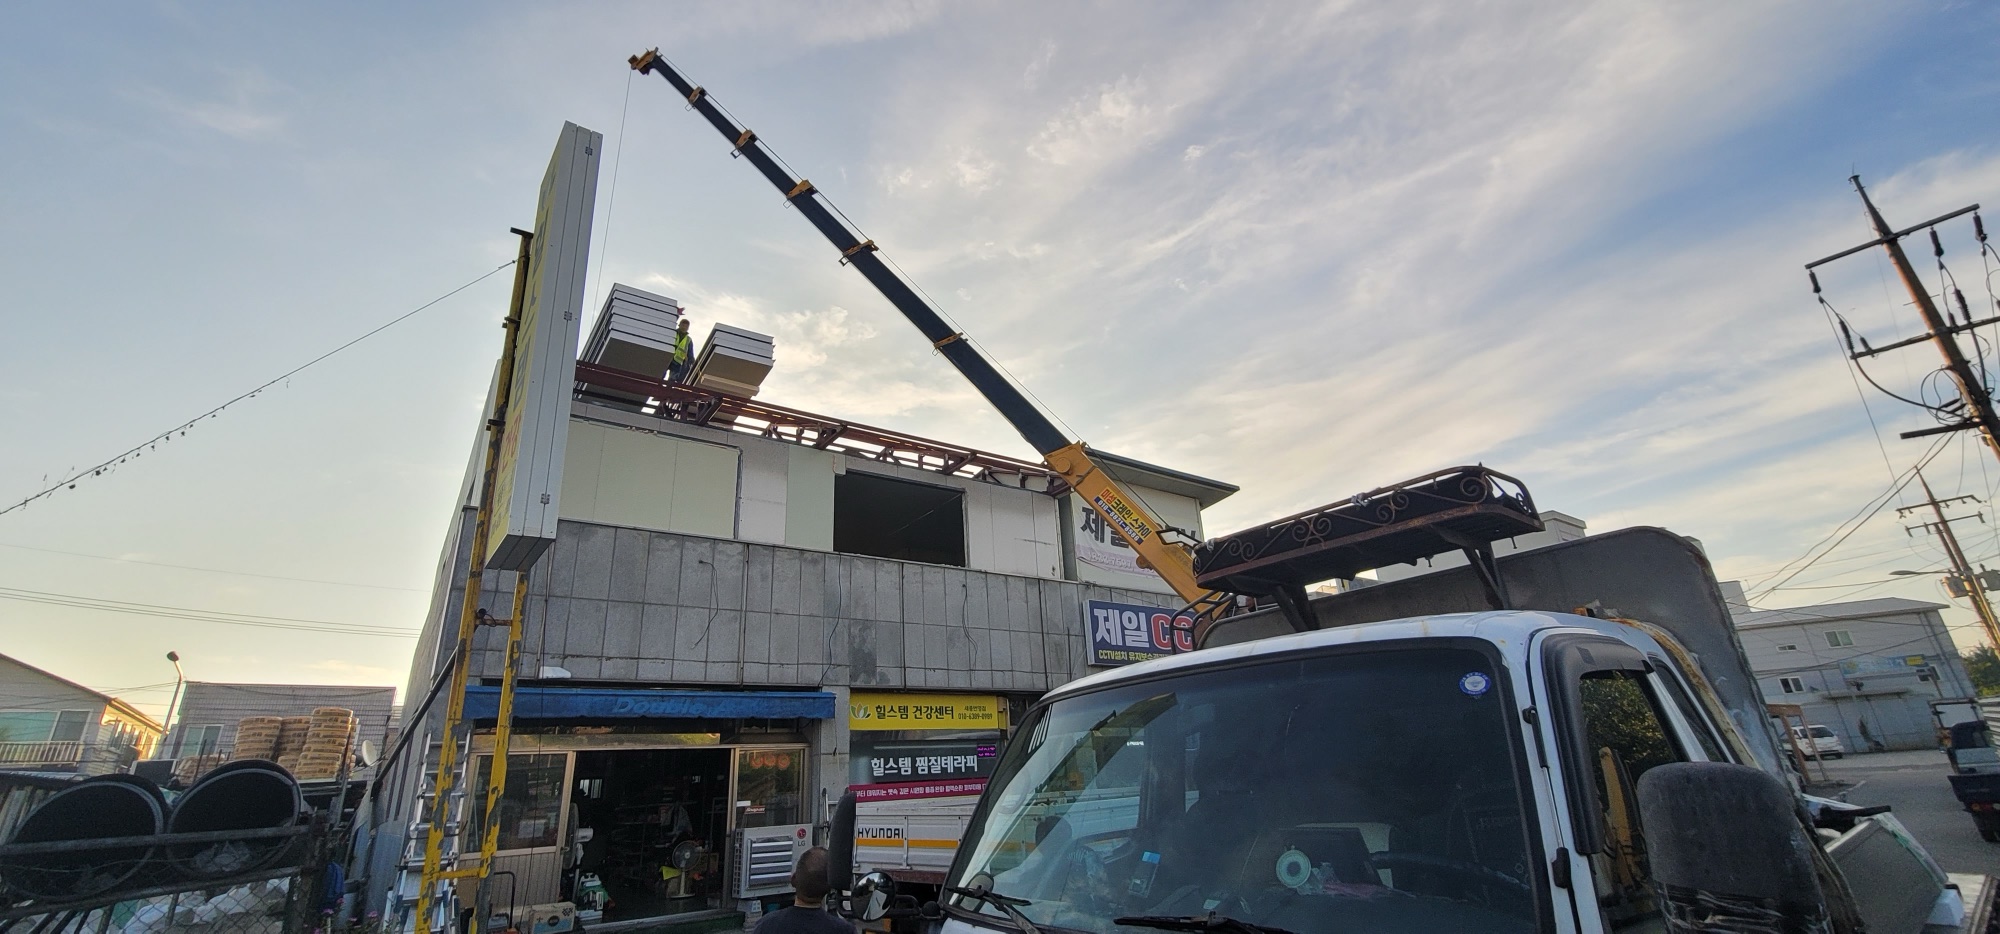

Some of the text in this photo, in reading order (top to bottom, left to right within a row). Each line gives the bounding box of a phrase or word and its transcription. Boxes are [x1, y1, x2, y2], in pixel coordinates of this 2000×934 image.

[1098, 649, 1128, 660] CCTV설치
[875, 705, 954, 720] 힐스템 건강센터
[871, 755, 978, 776] 힐스템 찜질테라피
[857, 827, 904, 839] HYUNDAI
